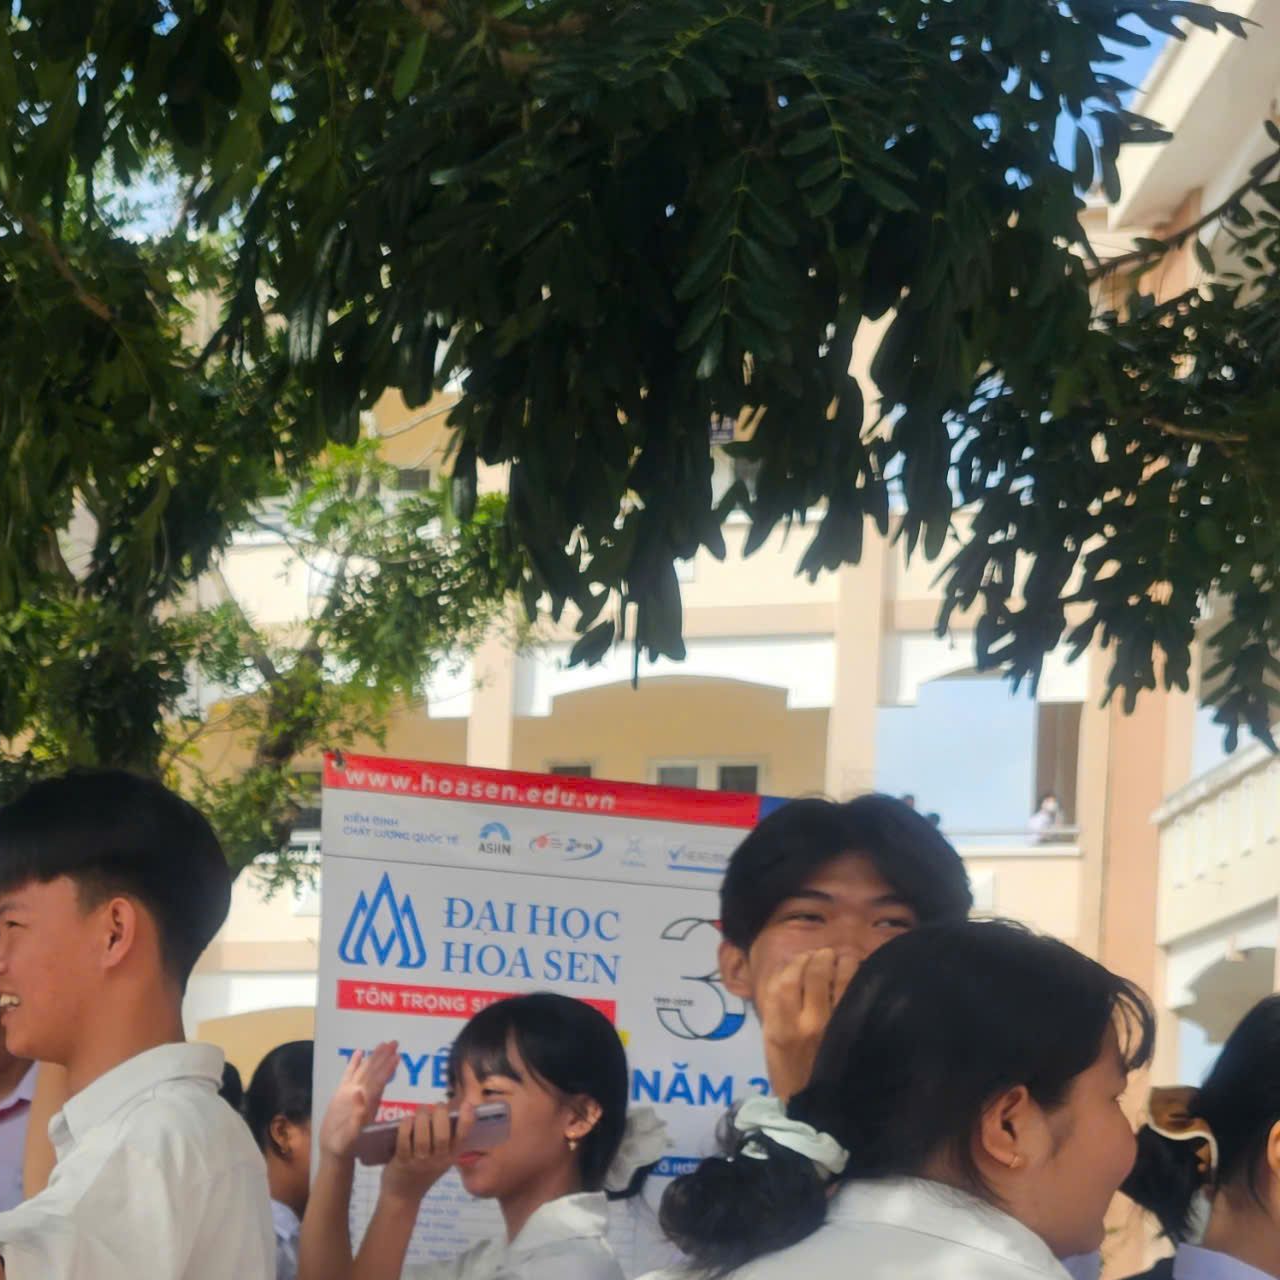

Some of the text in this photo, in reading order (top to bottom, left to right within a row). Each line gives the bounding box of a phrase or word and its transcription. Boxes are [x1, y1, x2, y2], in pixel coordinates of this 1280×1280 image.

[345, 768, 616, 810] www.hoasen.edu.vn
[478, 841, 511, 856] ASIIN
[442, 896, 620, 944] ĐẠI HỌC
[441, 941, 622, 985] HOA SEN
[354, 986, 394, 1007] TÔN
[400, 991, 466, 1013] TRỌNG
[631, 1061, 734, 1109] NĂM
